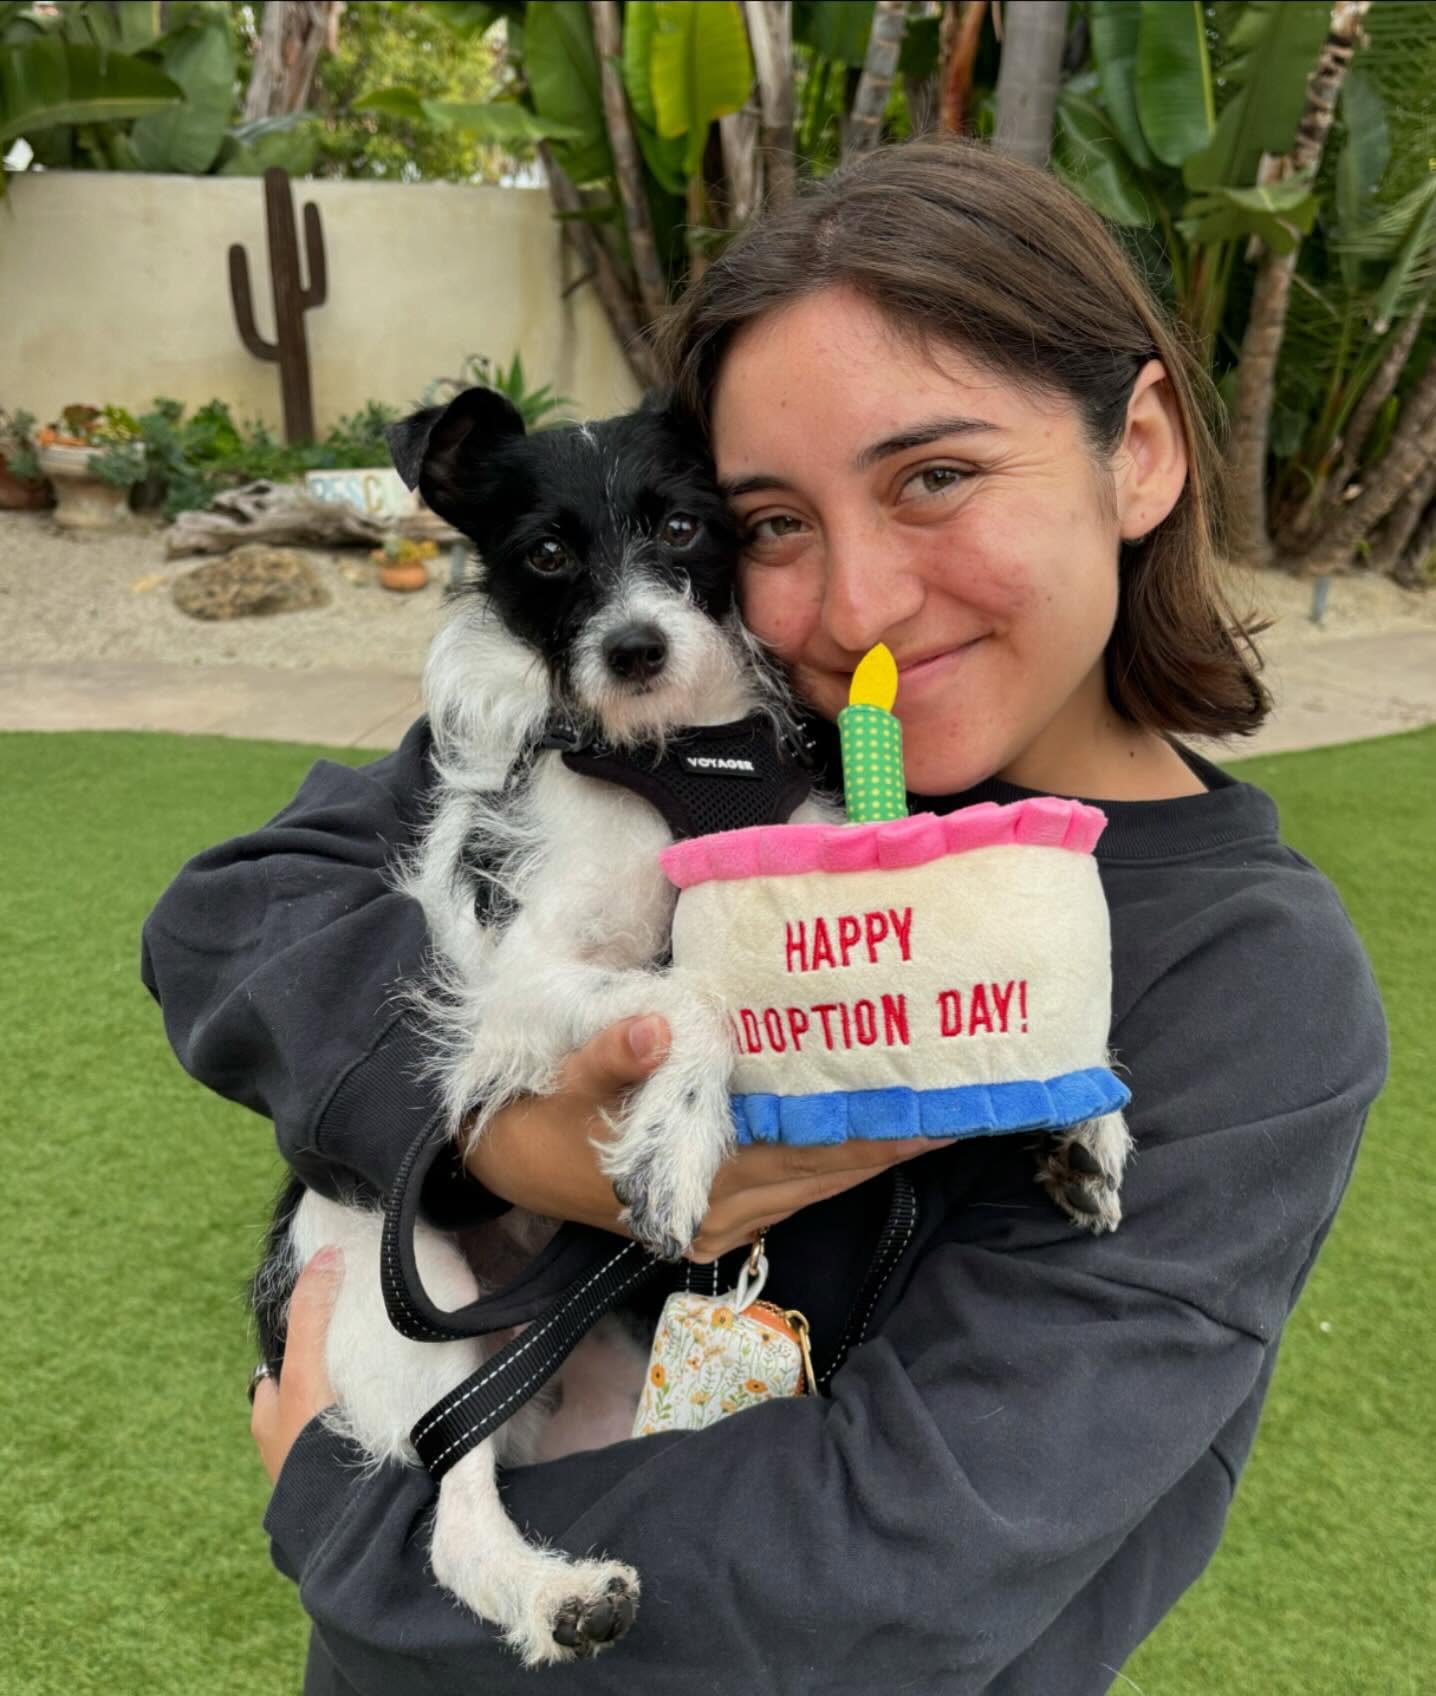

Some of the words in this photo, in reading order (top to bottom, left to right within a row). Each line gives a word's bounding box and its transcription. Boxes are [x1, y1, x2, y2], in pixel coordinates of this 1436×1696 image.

[686, 757, 755, 771] VOYAGER
[785, 907, 912, 972] HAPPY
[937, 980, 1028, 1037] DAY!
